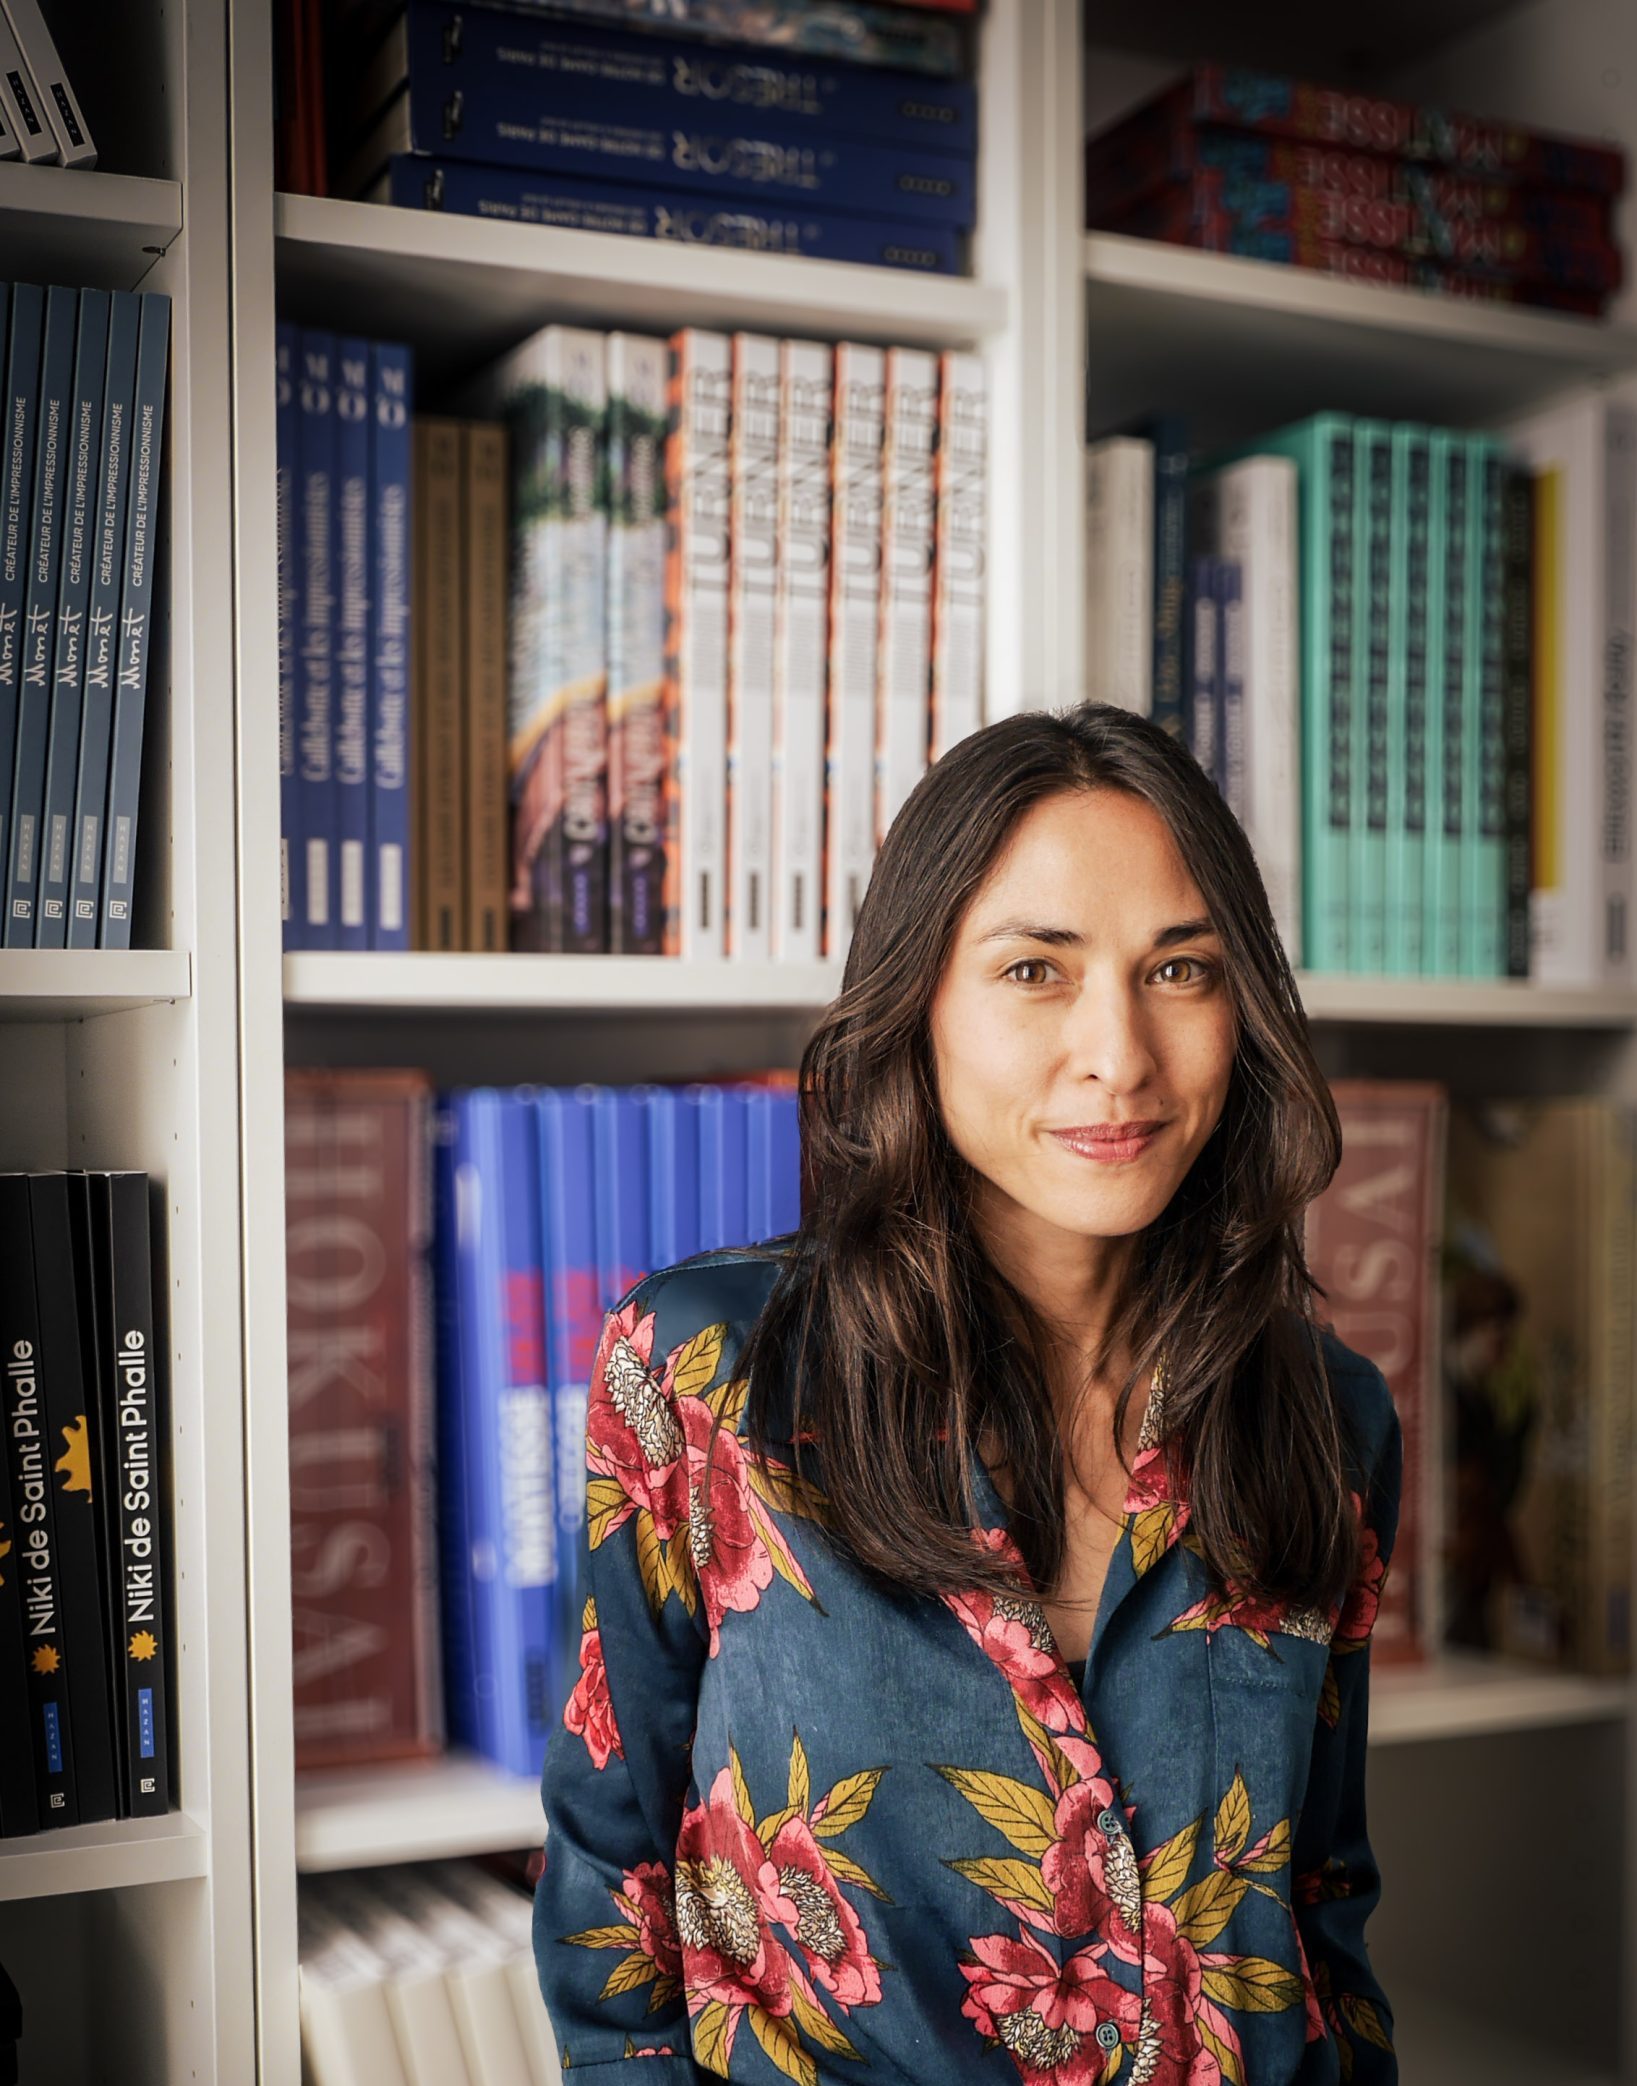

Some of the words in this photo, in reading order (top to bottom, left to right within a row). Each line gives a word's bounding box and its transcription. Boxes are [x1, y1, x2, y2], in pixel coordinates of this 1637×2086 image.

[9, 397, 26, 505] L'IMPRESSIONNISME
[43, 399, 59, 506] L'IMPRESSIONNISME
[75, 402, 91, 508] L'IMPRESSIONNISME
[105, 404, 122, 510] L'IMPRESSIONNISME
[137, 405, 153, 511] L'IMPRESSIONNISME
[687, 368, 731, 594] TURNER
[735, 371, 779, 597] TURNER
[8, 507, 19, 521] DE
[42, 509, 52, 523] DE
[74, 511, 84, 525] DE
[104, 512, 115, 526] DE
[136, 513, 147, 528] DE
[785, 374, 829, 600] TURNER
[838, 379, 884, 603] TURNER
[892, 382, 936, 605] TURNER
[944, 387, 984, 609] TURNER
[5, 525, 18, 581] CRÉATEUR
[38, 527, 51, 583] CRÉATEUR
[70, 528, 83, 584] CRÉATEUR
[100, 530, 114, 585] CRÉATEUR
[132, 531, 146, 587] CRÉATEUR
[8, 1339, 40, 1438] Phalle
[118, 1330, 146, 1427] Phalle
[286, 1109, 391, 1739] HOKUSAI
[19, 1443, 46, 1522] Saint
[123, 1431, 150, 1510] Saint
[22, 1530, 50, 1570] de
[124, 1517, 152, 1558] de
[27, 1577, 56, 1636] Niki
[127, 1566, 154, 1622] Niki
[48, 1712, 57, 1760] HAZAN
[141, 1698, 151, 1745] HAZAN
